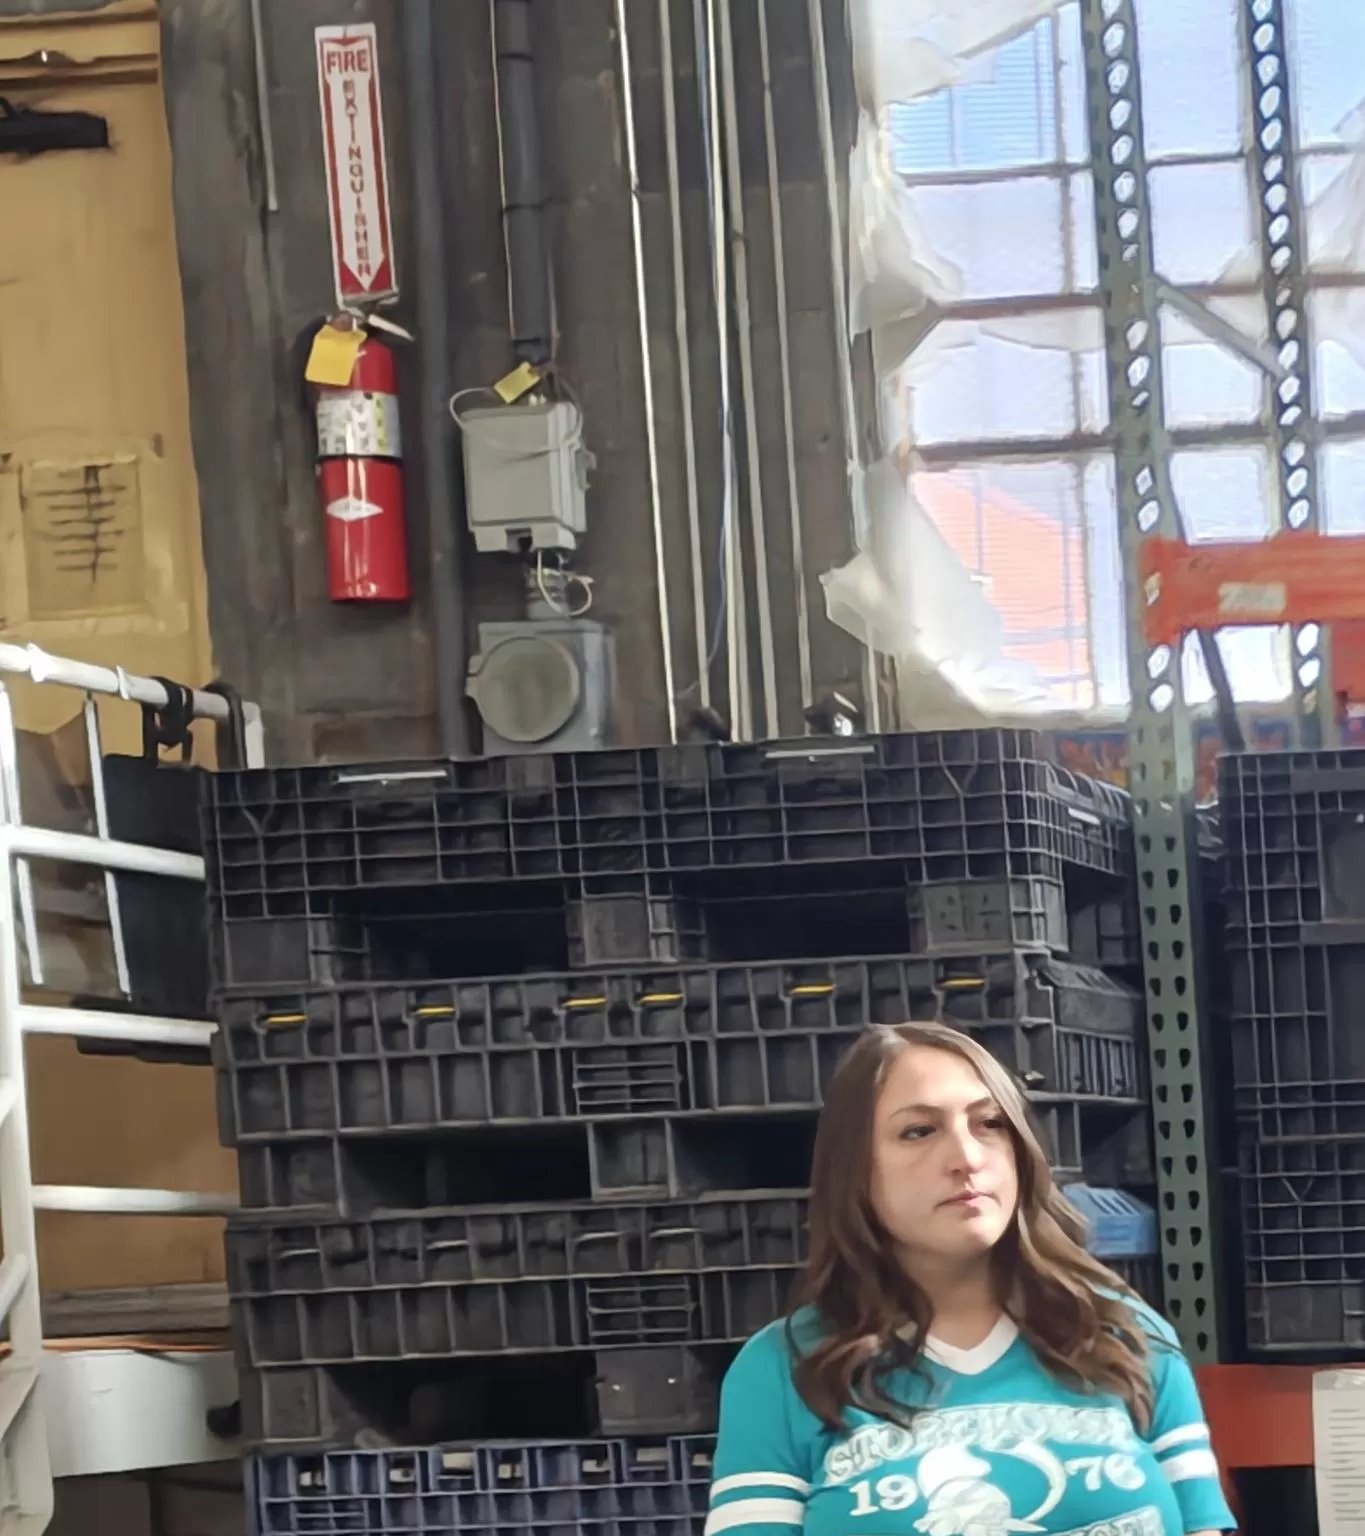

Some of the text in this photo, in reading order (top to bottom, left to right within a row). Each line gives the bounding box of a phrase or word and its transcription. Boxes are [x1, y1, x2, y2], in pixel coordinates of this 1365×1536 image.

[327, 50, 369, 74] FIRE
[343, 79, 371, 277] EXTINGUISHER
[849, 1452, 1147, 1516] 19 76
